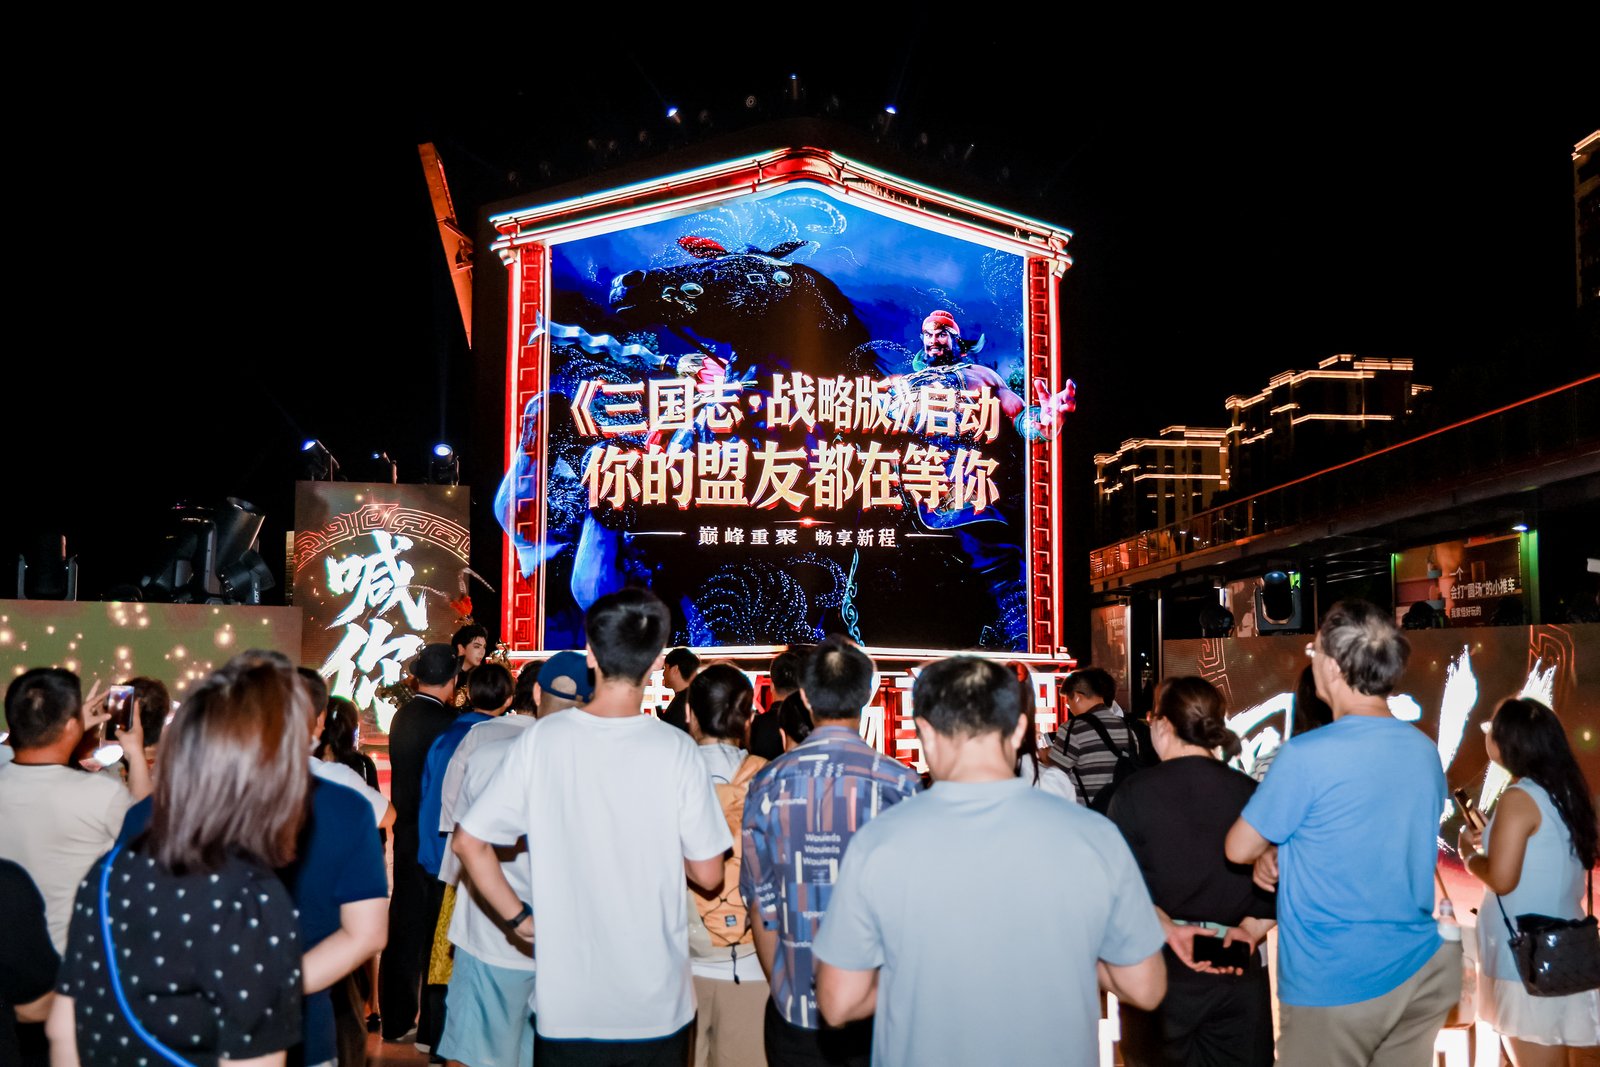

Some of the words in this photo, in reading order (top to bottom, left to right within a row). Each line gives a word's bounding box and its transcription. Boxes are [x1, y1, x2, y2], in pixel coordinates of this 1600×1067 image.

[581, 440, 1000, 514] 你的盟友都在等你
[699, 526, 798, 546] 巅峰重聚
[815, 528, 897, 547] 畅享新程
